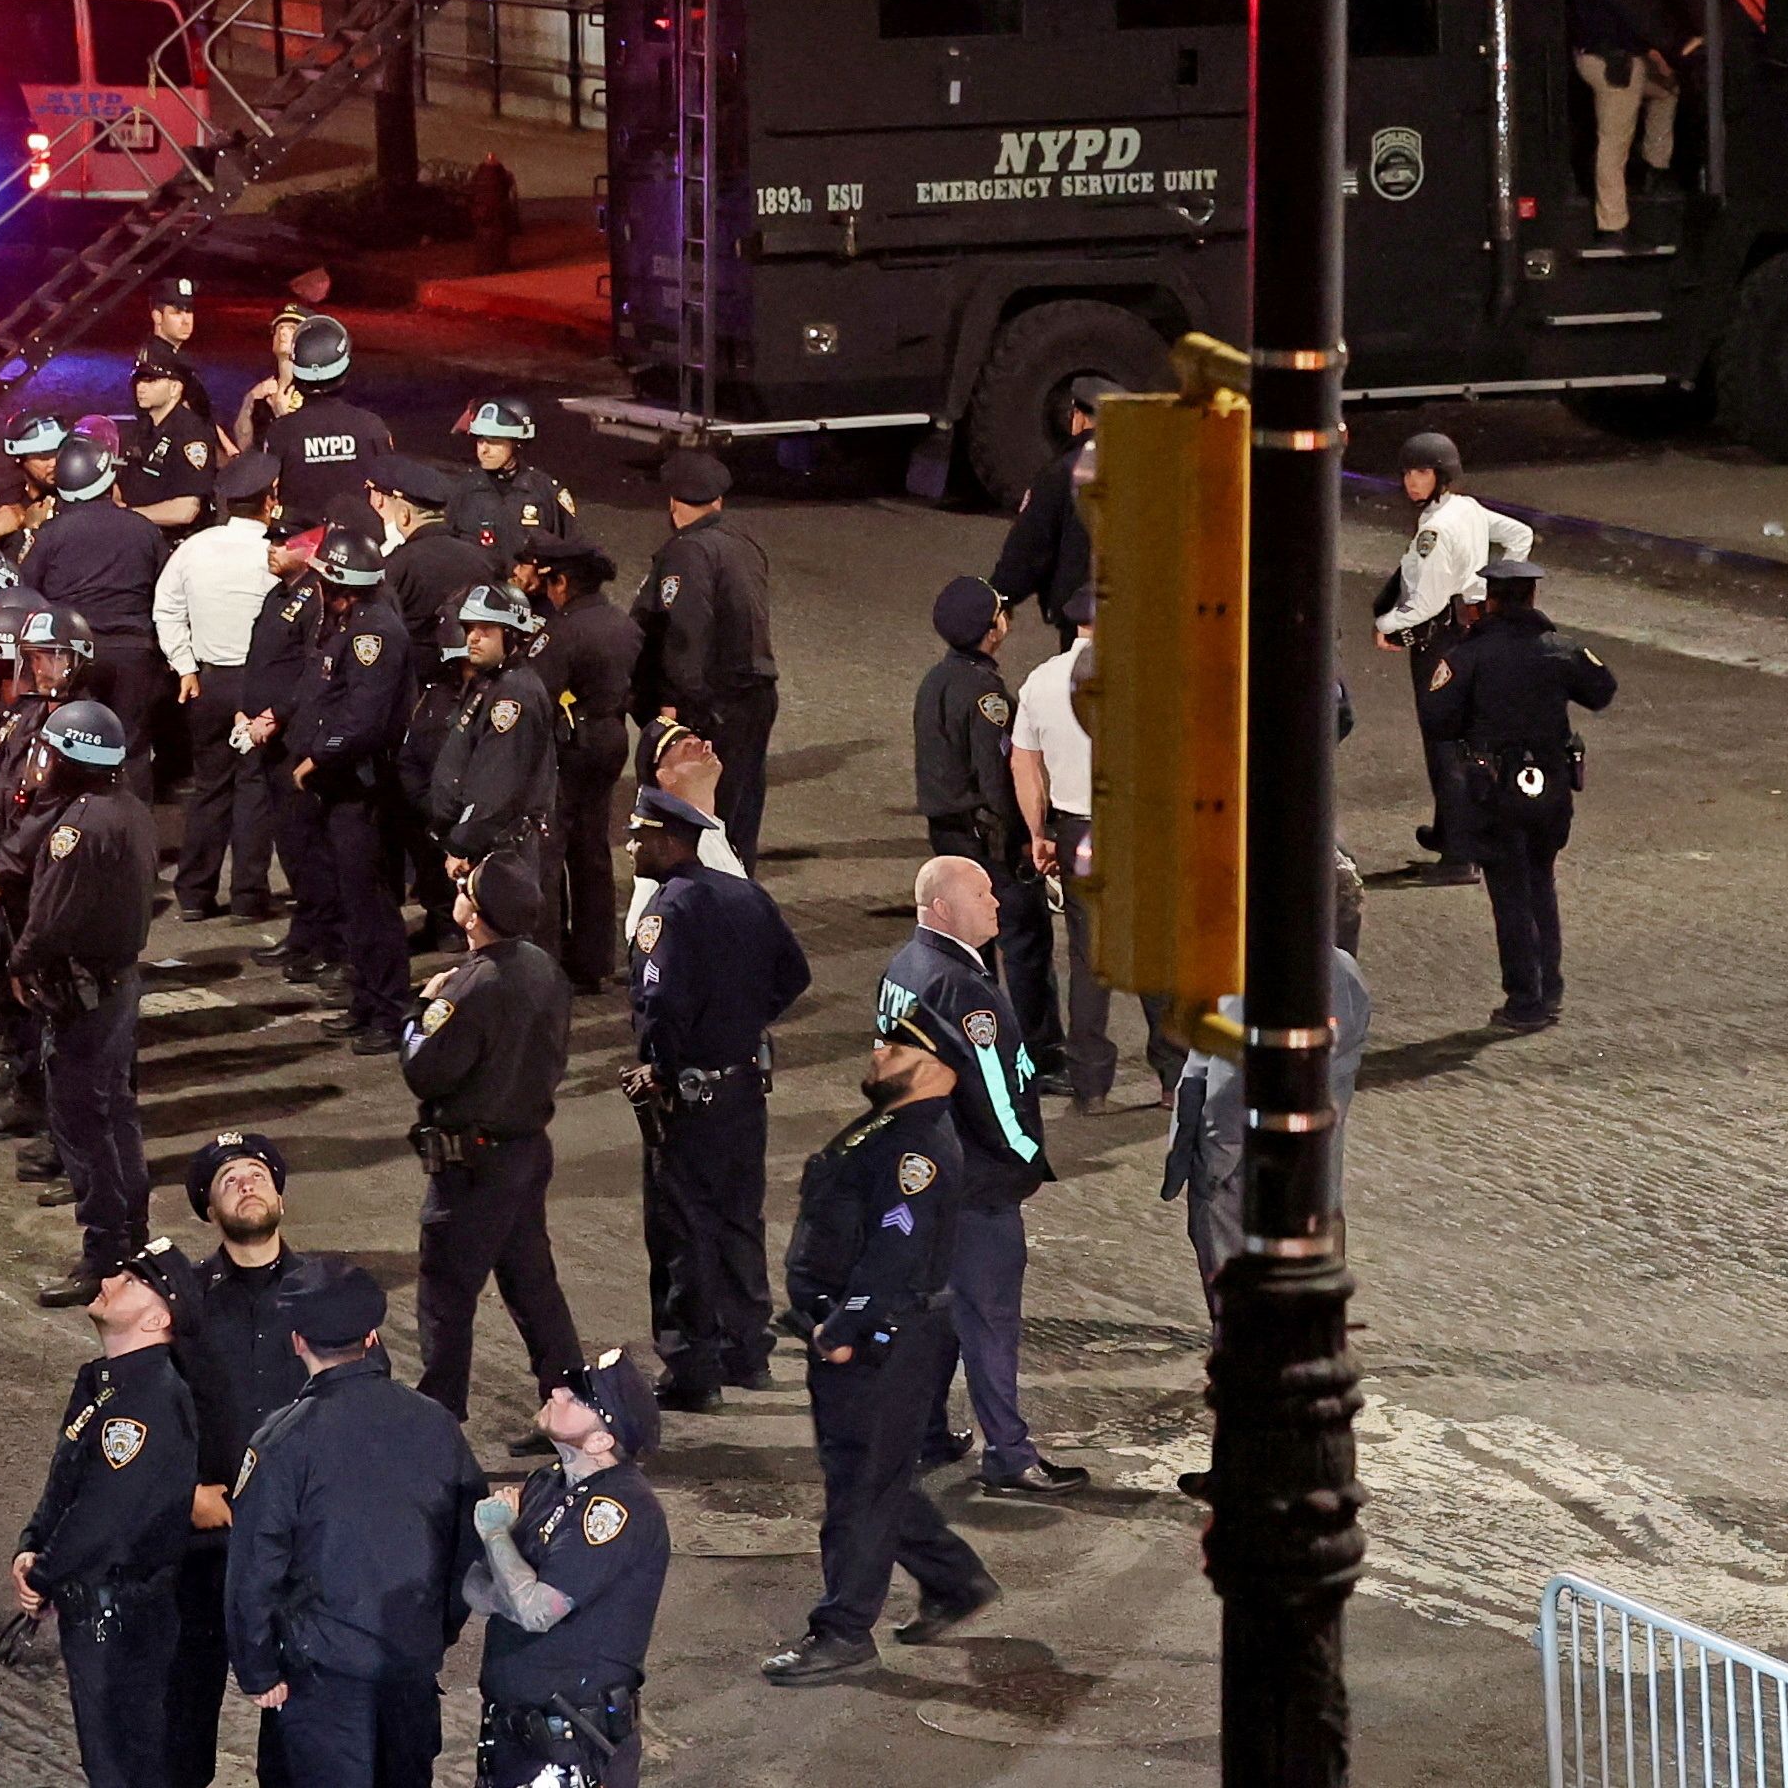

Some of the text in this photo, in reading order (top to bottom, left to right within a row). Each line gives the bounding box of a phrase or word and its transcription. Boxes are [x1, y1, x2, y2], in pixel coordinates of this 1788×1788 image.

[46, 92, 123, 105] NYPD
[994, 127, 1141, 175] NYPD
[756, 186, 802, 215] 1893
[827, 183, 863, 211] ESU
[917, 169, 1219, 204] EMERGENCY SERVICE UNIT
[304, 435, 355, 457] NYPD
[65, 728, 102, 745] 27126
